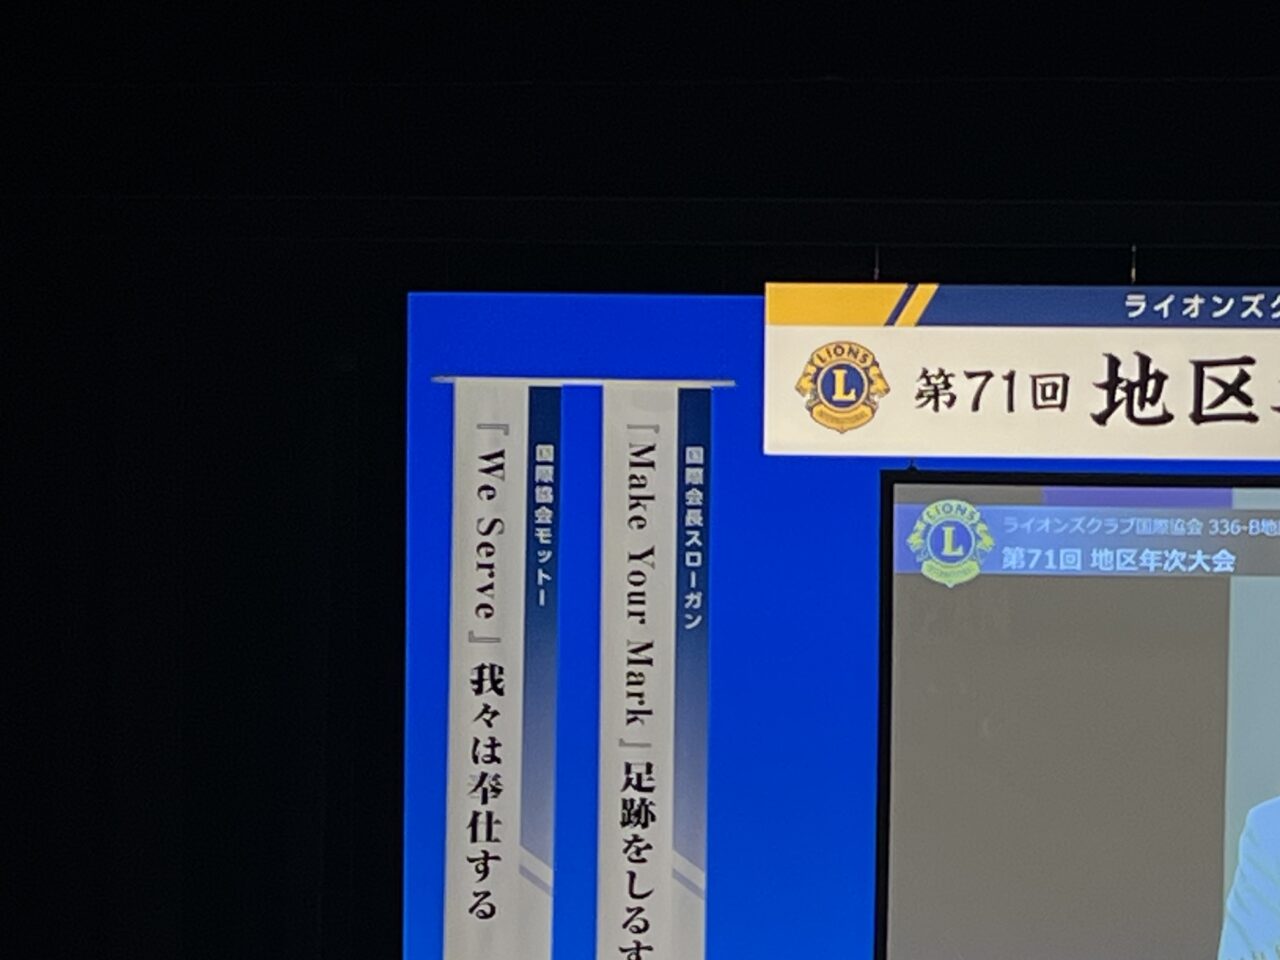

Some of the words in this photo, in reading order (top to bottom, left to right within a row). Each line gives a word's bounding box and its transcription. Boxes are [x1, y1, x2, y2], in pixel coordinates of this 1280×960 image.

[816, 344, 870, 364] LIONS
[832, 368, 856, 402] L
[914, 367, 1070, 414] 第71回
[926, 503, 974, 519] LIONS
[1002, 516, 1203, 537] ライオンズクラブ国際協会
[942, 526, 964, 556] L
[1001, 547, 1082, 571] 第71回
[1090, 548, 1236, 573] 地区年次大会
[626, 545, 656, 625] Your
